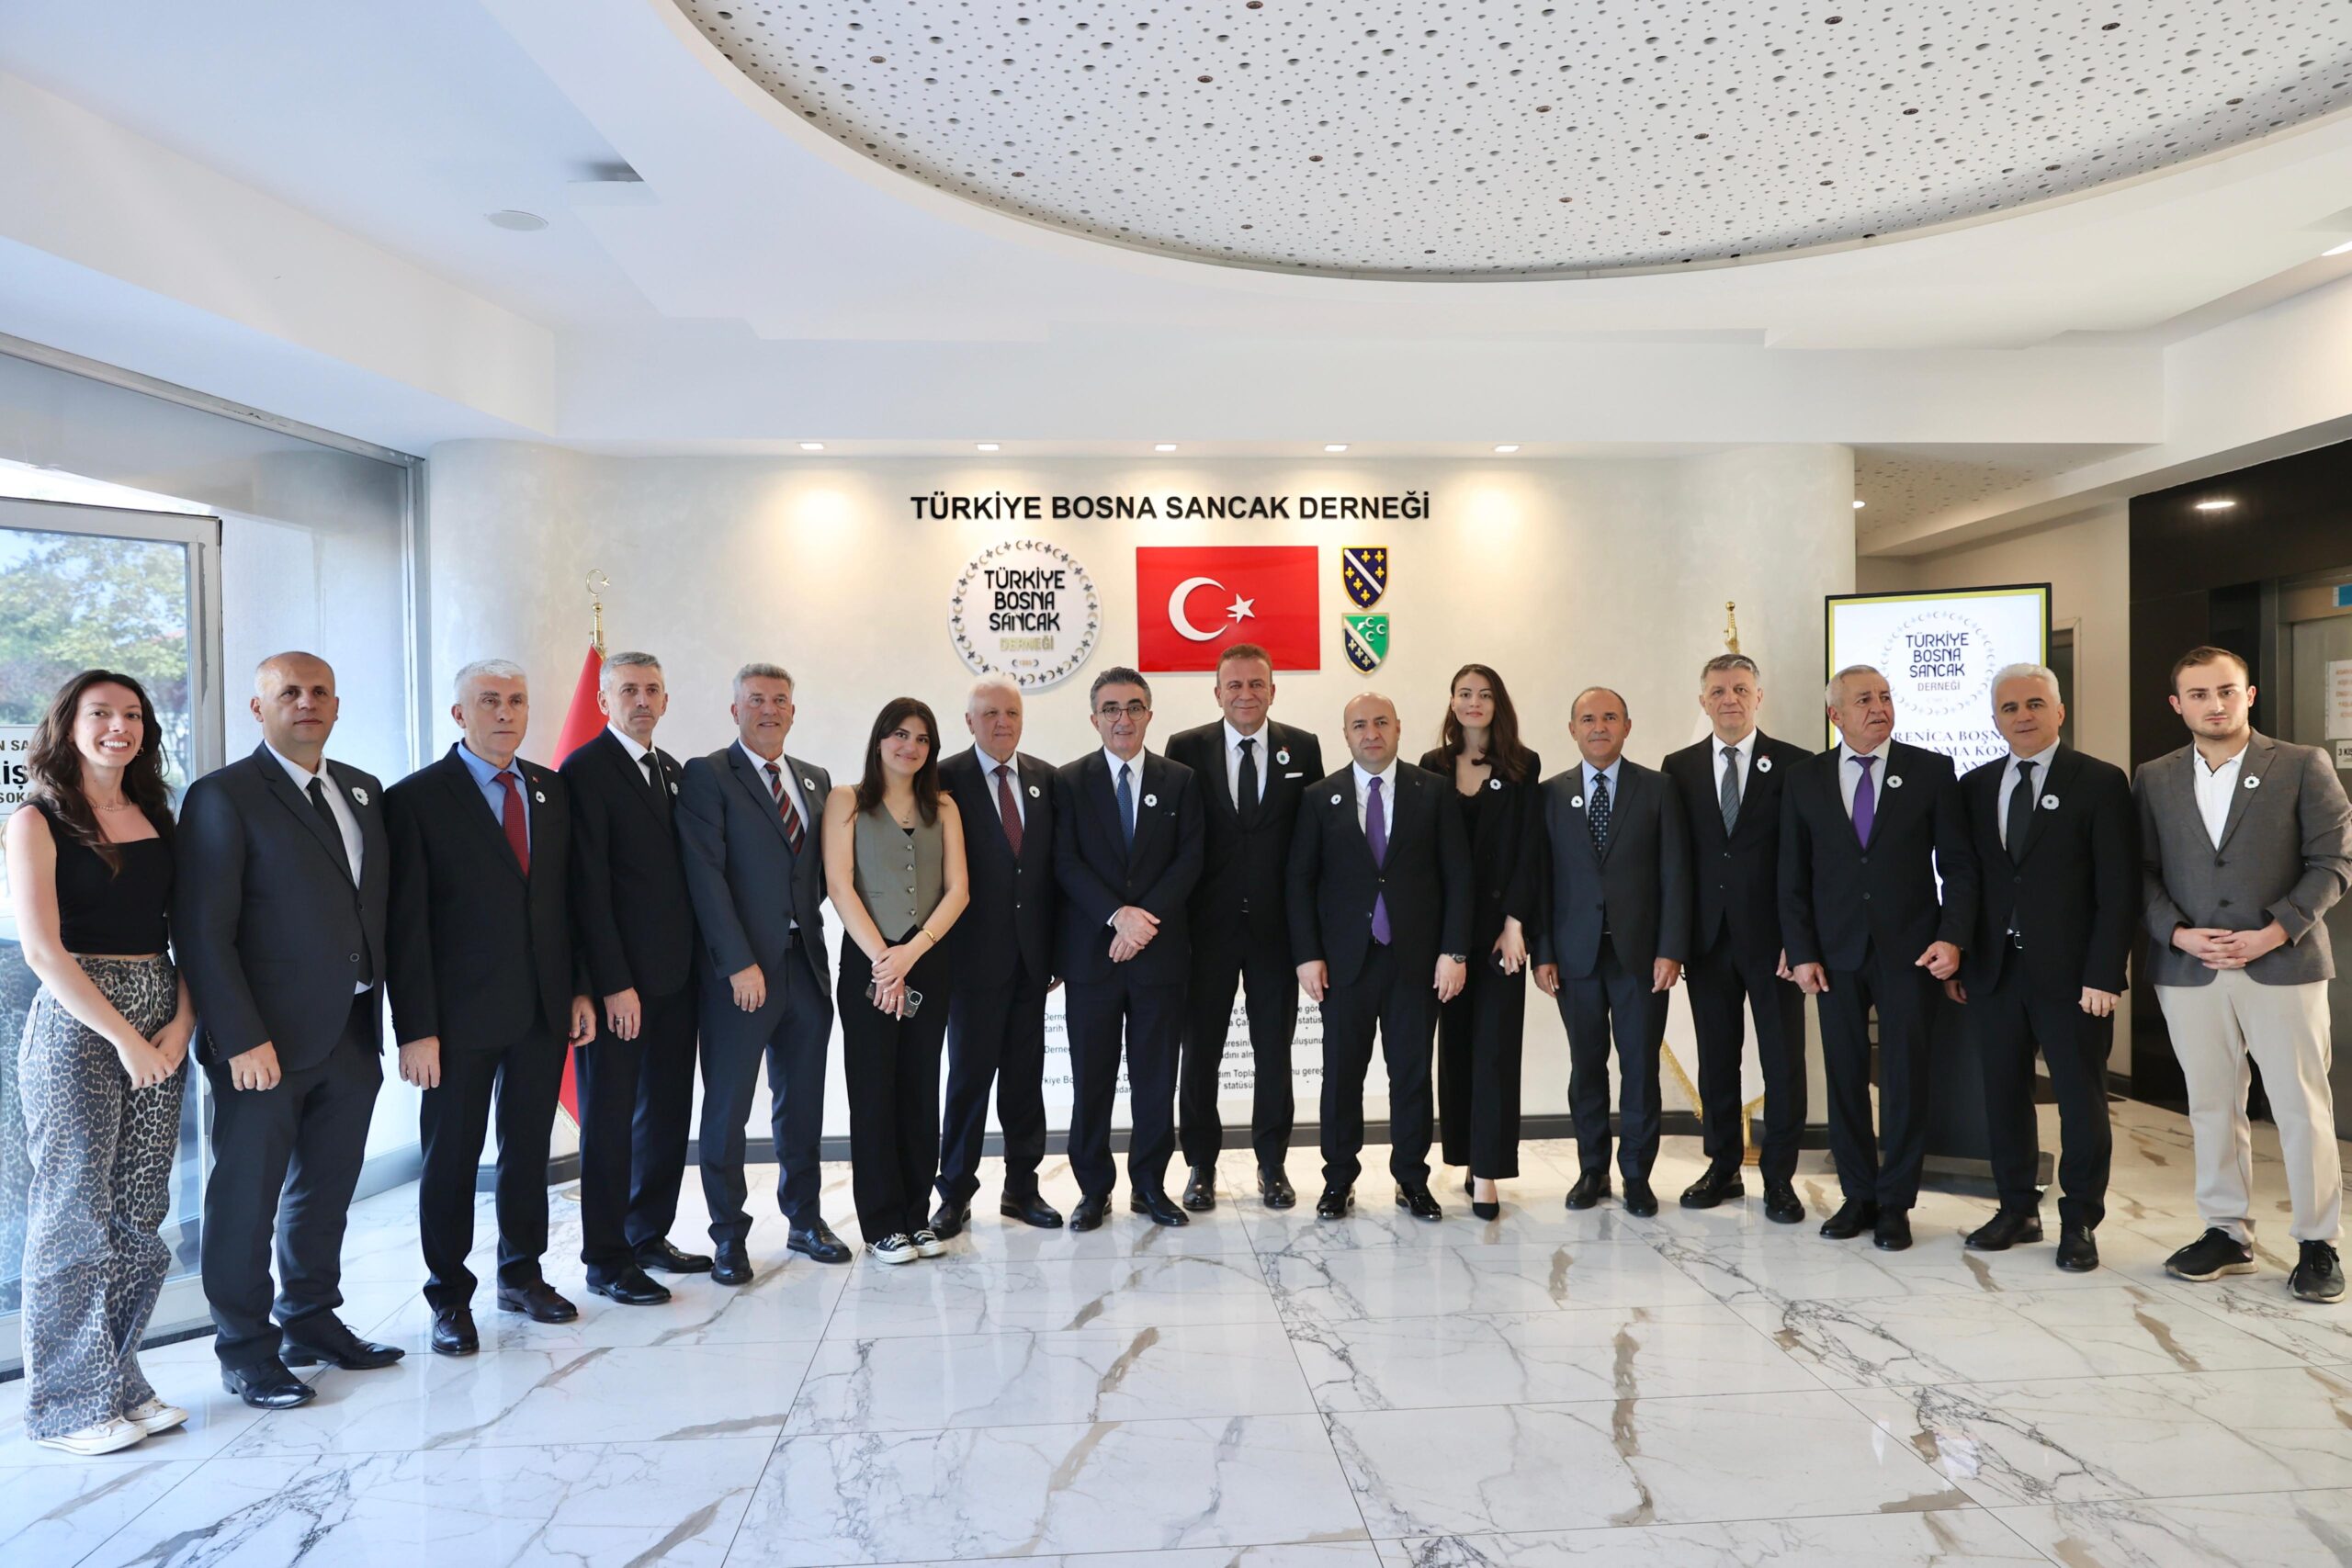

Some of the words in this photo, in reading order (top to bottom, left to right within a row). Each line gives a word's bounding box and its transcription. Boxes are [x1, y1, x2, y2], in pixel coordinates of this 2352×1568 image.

[910, 491, 1042, 520] TÜRKİYE
[1052, 496, 1158, 520] BOSNA
[1166, 496, 1291, 520] SANCAK
[1300, 491, 1430, 519] DERNEĞİ
[984, 567, 1066, 590] TÜRKİYE
[994, 591, 1055, 611] BOSNA
[989, 612, 1061, 631] SANCAK
[1905, 630, 1970, 649] TÜRKİYE
[1913, 648, 1962, 663] BOSNA
[1909, 663, 1966, 678] SANCAK
[1917, 680, 1961, 692] DERNEĞİ
